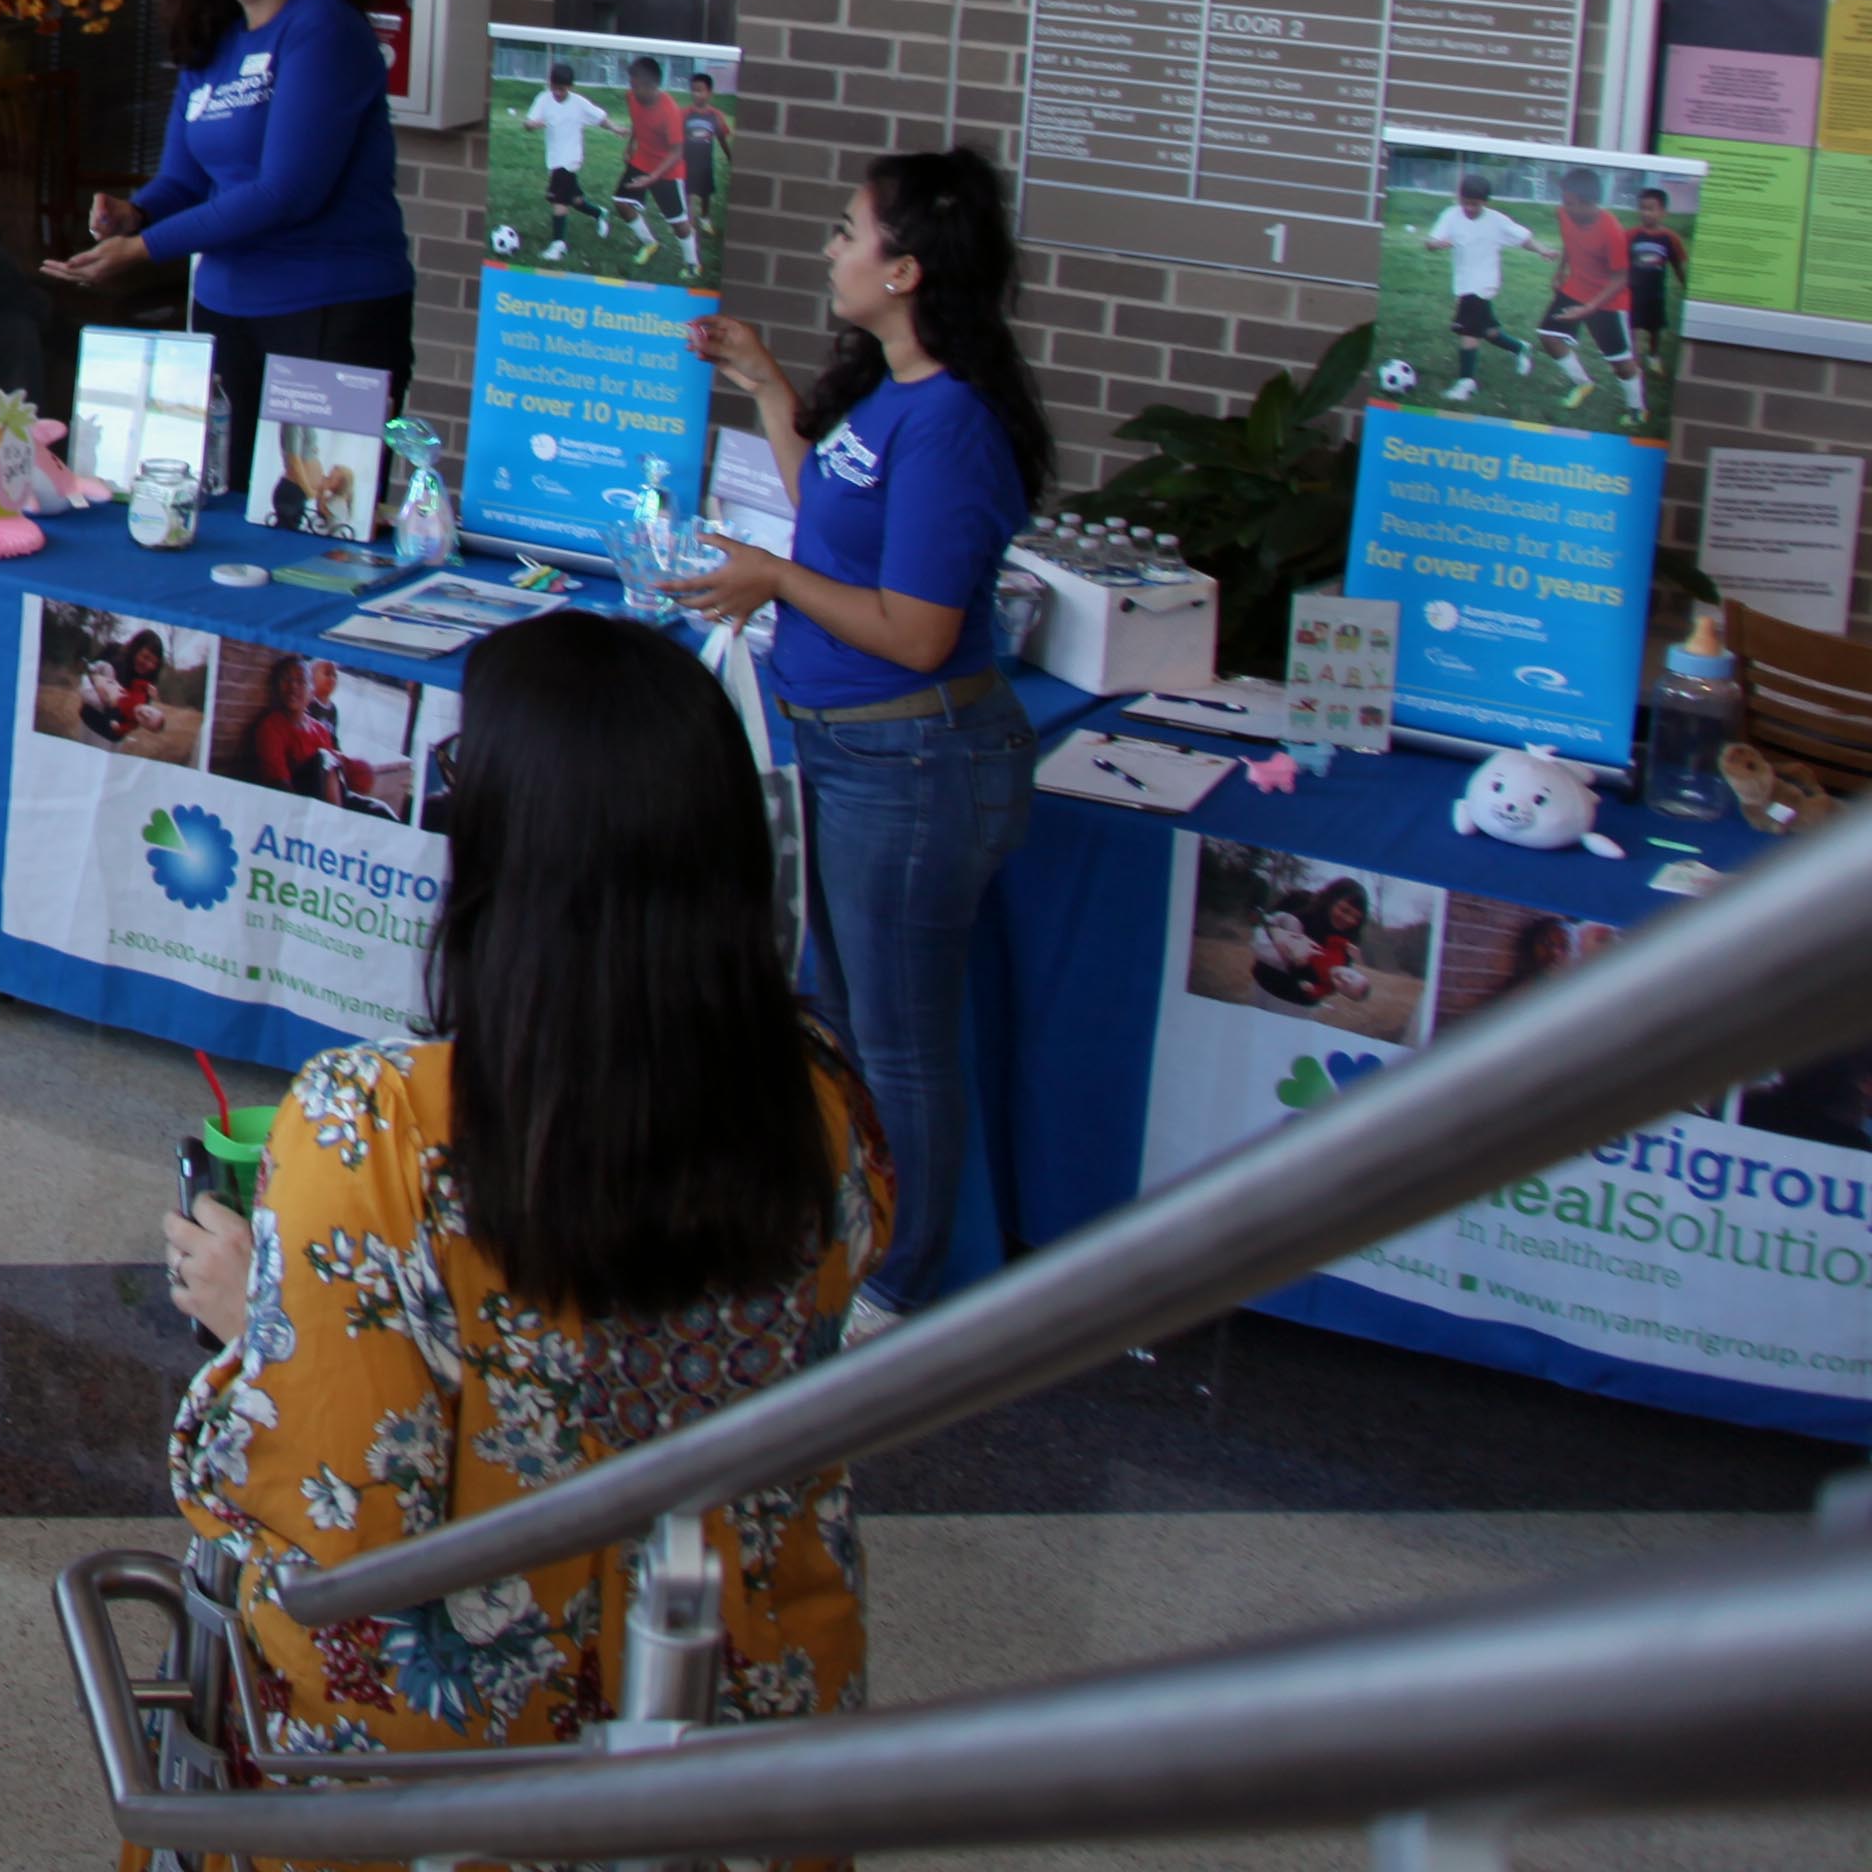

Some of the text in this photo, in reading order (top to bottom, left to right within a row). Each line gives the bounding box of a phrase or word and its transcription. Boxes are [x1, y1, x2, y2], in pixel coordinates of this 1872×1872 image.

[1209, 11, 1305, 39] FLOOR 2
[1264, 223, 1285, 263] 1
[496, 291, 690, 339] Serving families
[500, 330, 678, 371] with Medicaid and
[496, 357, 596, 391] PeachCare
[600, 374, 627, 395] for
[485, 383, 686, 435] for over 10 years
[1383, 435, 1631, 496] Serving families
[1388, 480, 1617, 533] with Medicaid and
[1380, 511, 1512, 553] PeachCare
[1516, 533, 1552, 559] for
[1365, 540, 1624, 607] for over 10 years
[246, 911, 367, 962] in healthcare
[1456, 1213, 1684, 1290] in healthcare
